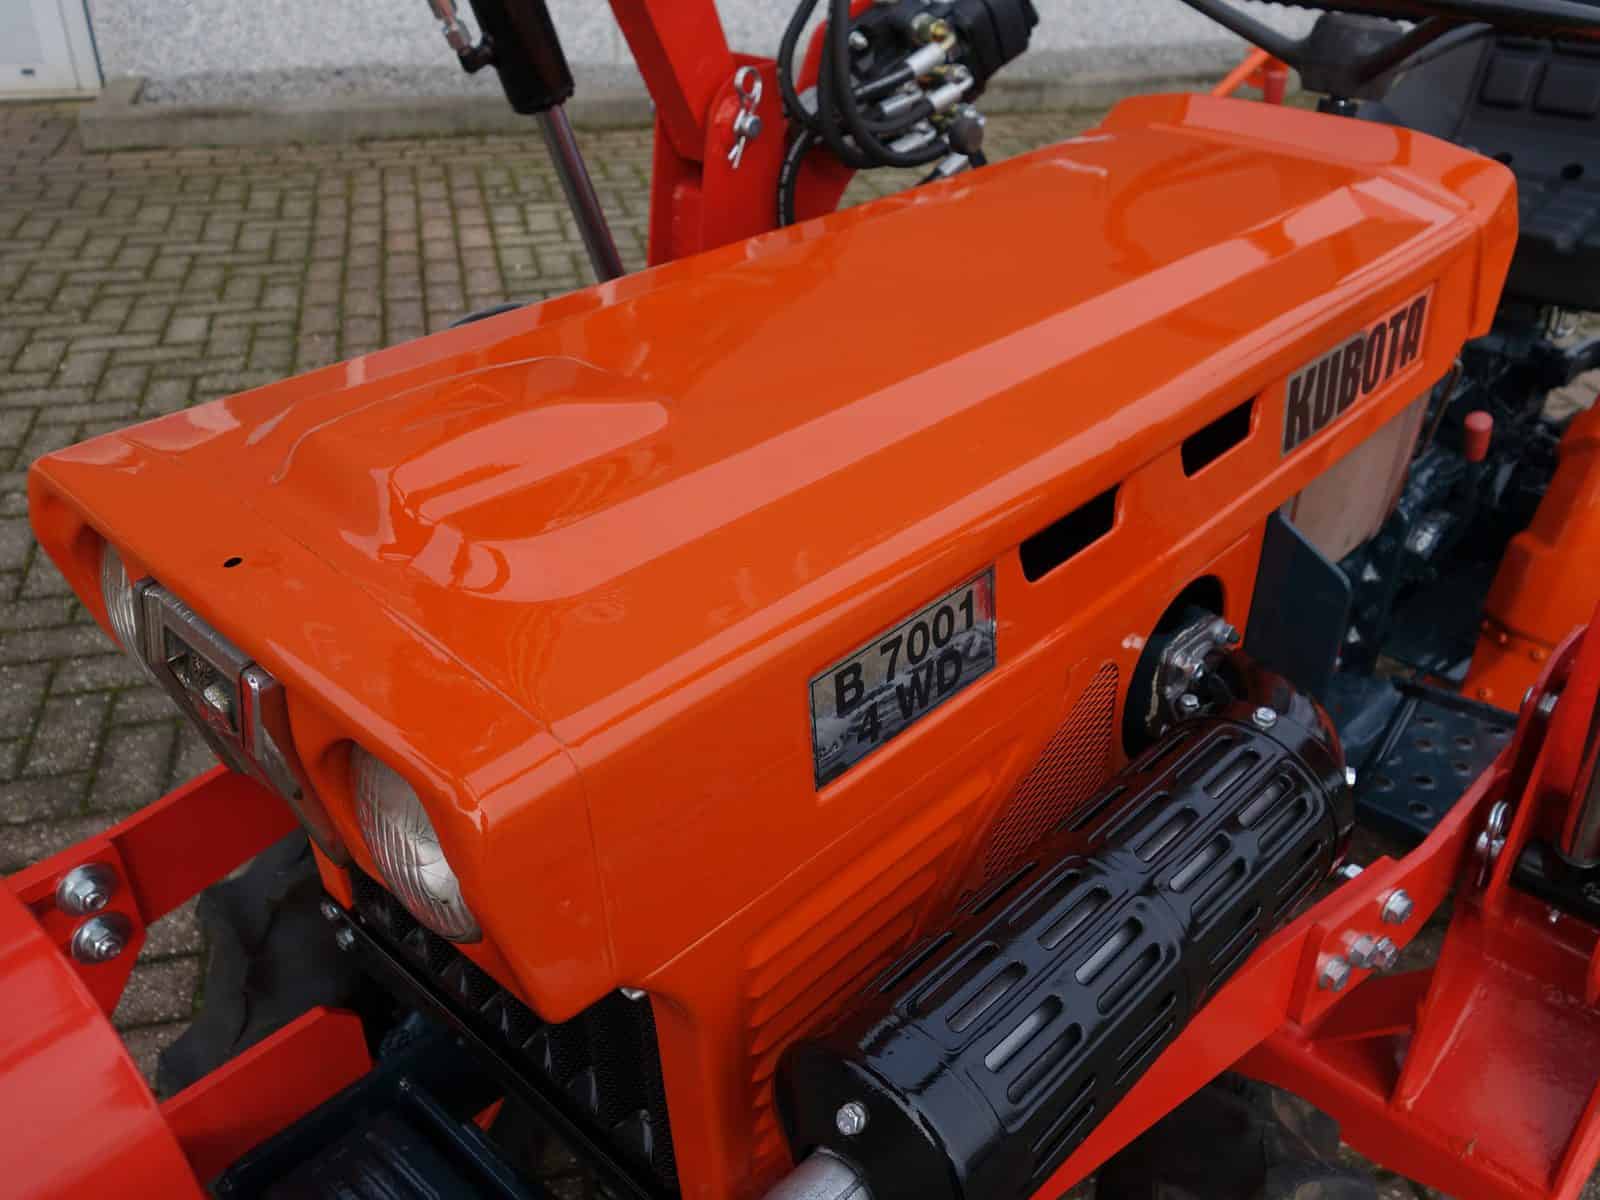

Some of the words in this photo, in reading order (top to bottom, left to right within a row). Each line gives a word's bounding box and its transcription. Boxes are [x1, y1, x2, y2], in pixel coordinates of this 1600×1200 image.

[1284, 296, 1428, 452] KUBOTA
[835, 662, 864, 718] B
[880, 590, 974, 683] 7001
[857, 702, 881, 743] 4
[896, 650, 962, 720] WD
